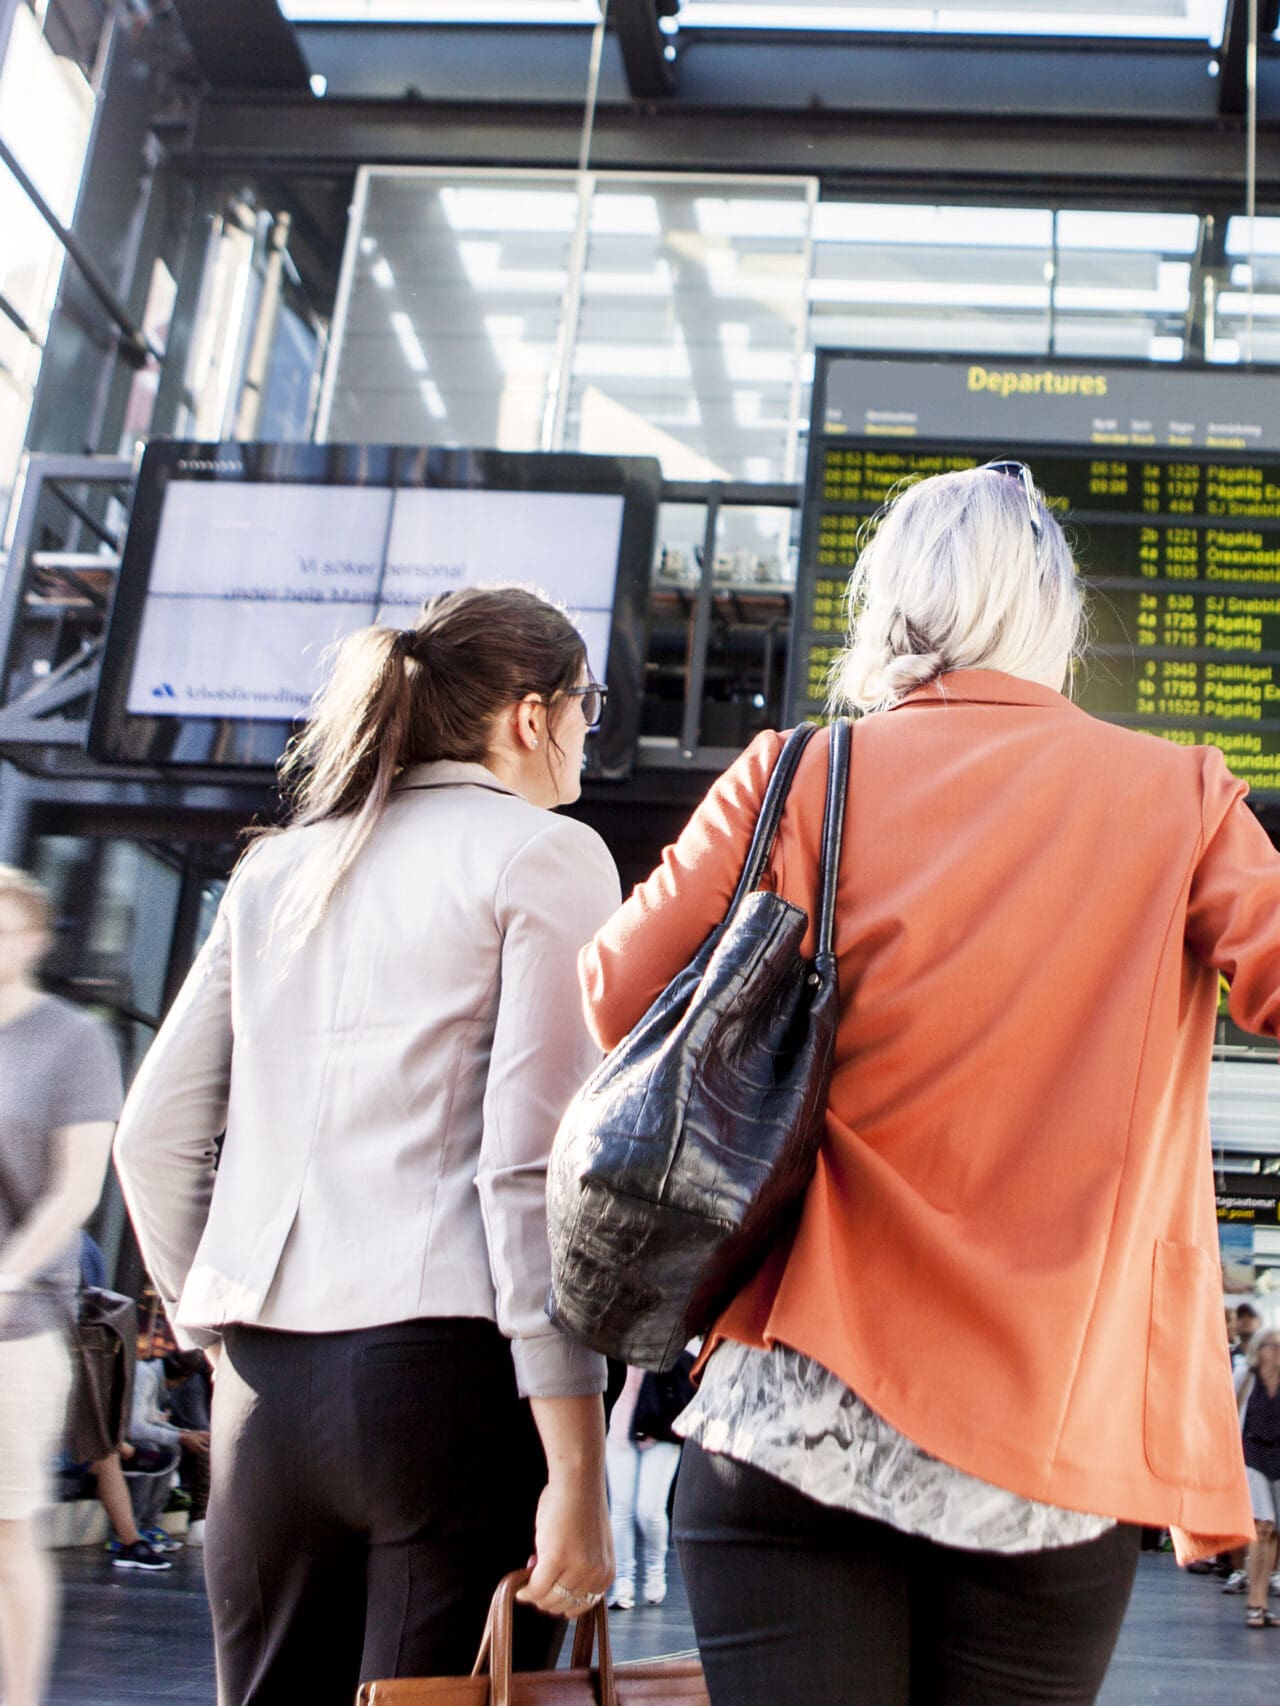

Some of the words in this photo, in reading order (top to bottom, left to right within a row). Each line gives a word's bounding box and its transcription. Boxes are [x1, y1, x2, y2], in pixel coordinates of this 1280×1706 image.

[967, 366, 1108, 396] Departures
[1206, 465, 1263, 484] Pågatåg
[1206, 482, 1263, 501] Pågatåg
[1206, 529, 1263, 549] Pågatåg
[1206, 596, 1225, 611] SJ
[1205, 613, 1263, 634] Pågatåg
[1205, 632, 1263, 652] Pågatåg
[1204, 682, 1263, 702] Pågatåg
[1204, 700, 1263, 720] Pågatåg
[1204, 732, 1263, 753] Pågatåg
